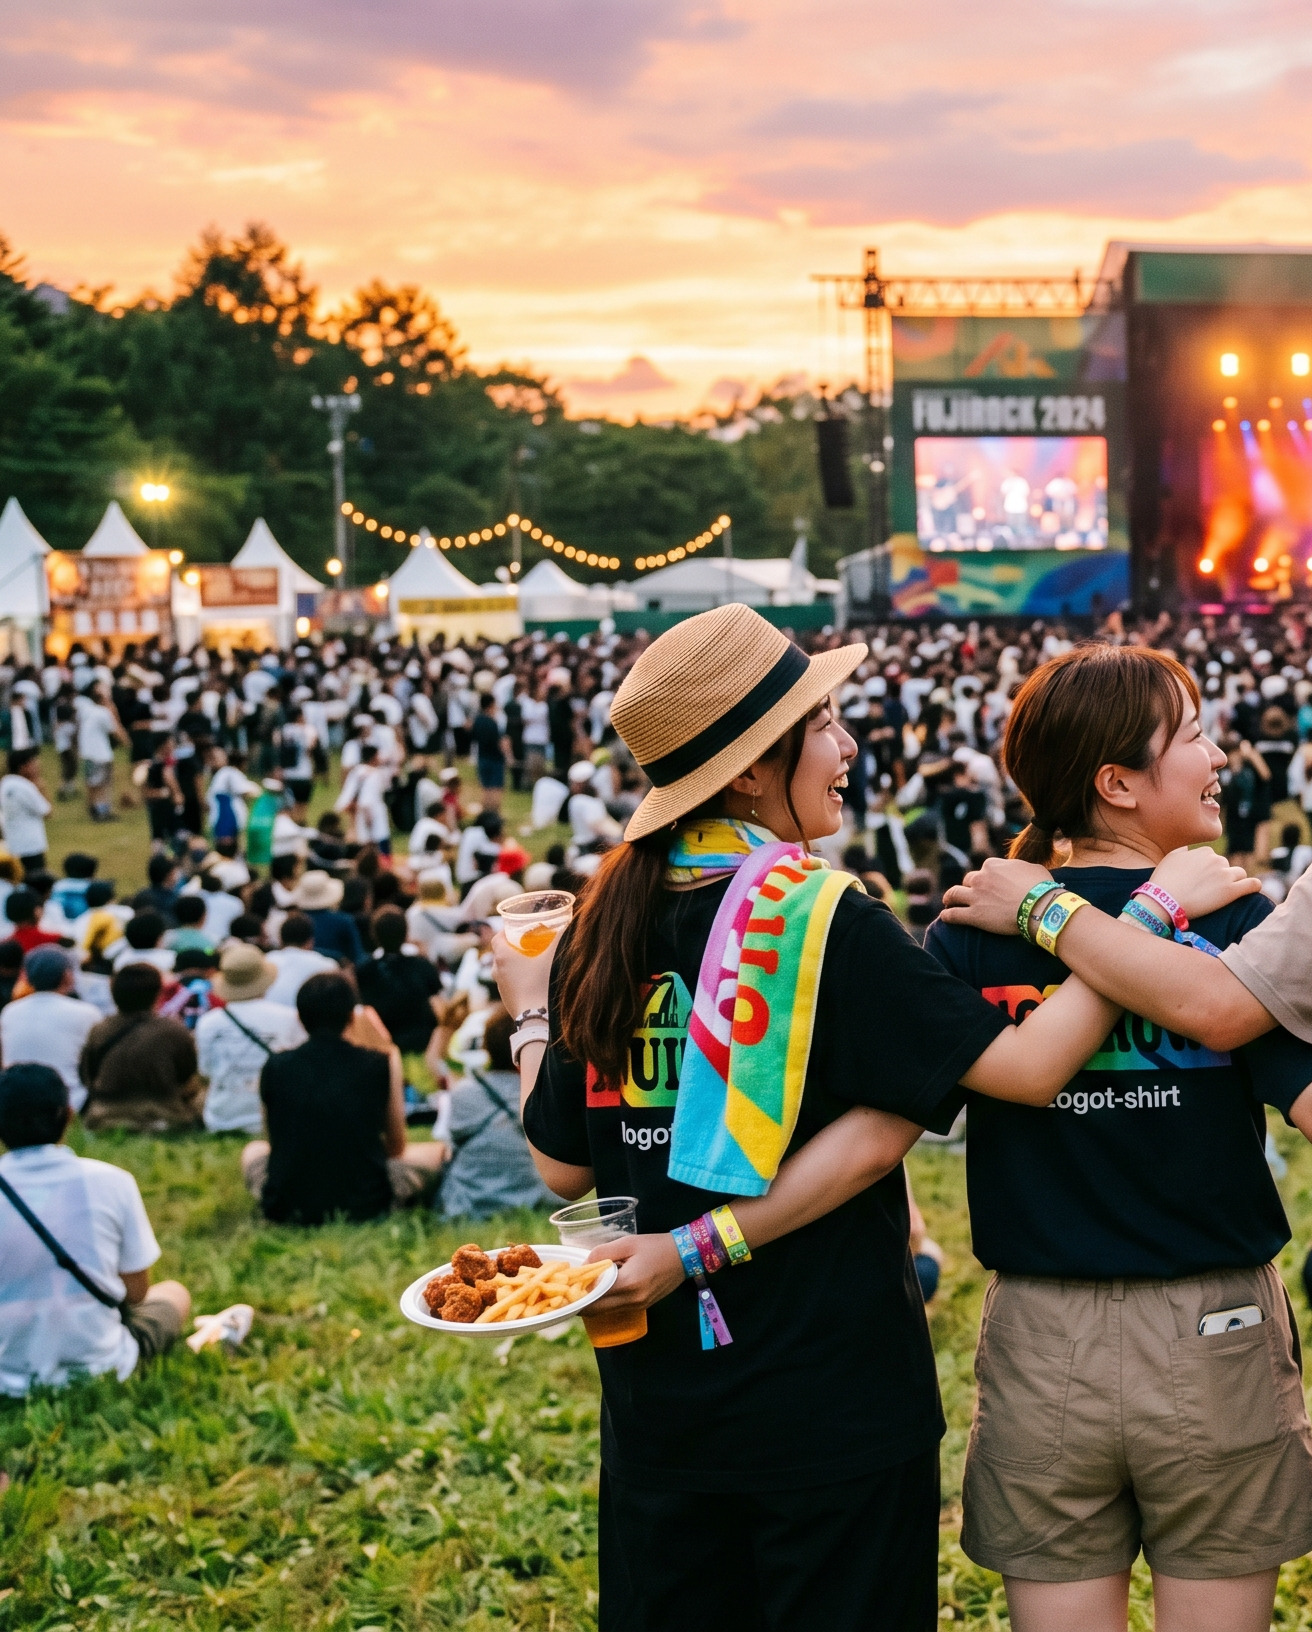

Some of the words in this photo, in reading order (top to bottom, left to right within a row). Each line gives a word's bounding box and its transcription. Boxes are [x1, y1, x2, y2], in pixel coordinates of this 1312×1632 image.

[912, 394, 1037, 432] FUJIROCK
[1039, 395, 1106, 432] 2024
[1047, 1085, 1181, 1115] ogot-shirt
[621, 1121, 674, 1151] logo
